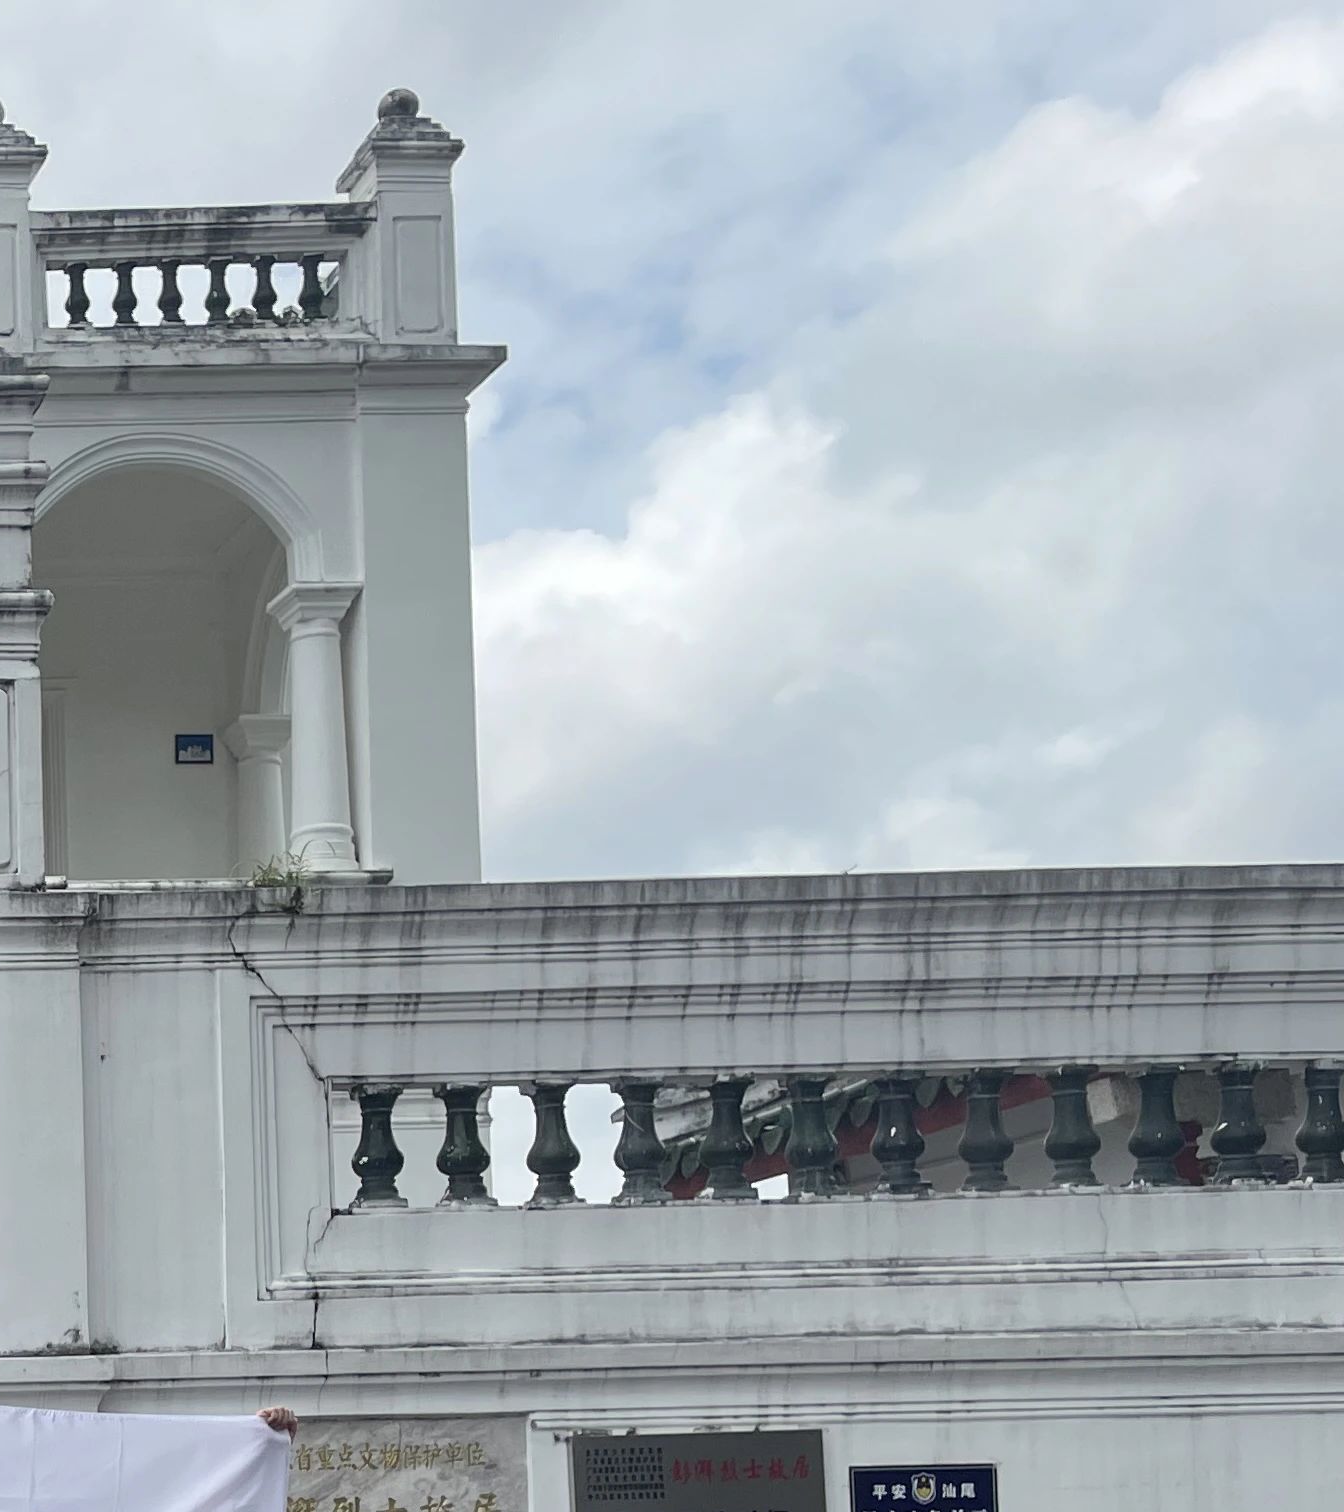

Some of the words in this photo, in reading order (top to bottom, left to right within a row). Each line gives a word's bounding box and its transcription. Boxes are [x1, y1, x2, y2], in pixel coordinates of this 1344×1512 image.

[289, 1442, 488, 1471] 省重点文物保护单位
[872, 1484, 907, 1500] 平安
[942, 1482, 976, 1499] 汕尾
